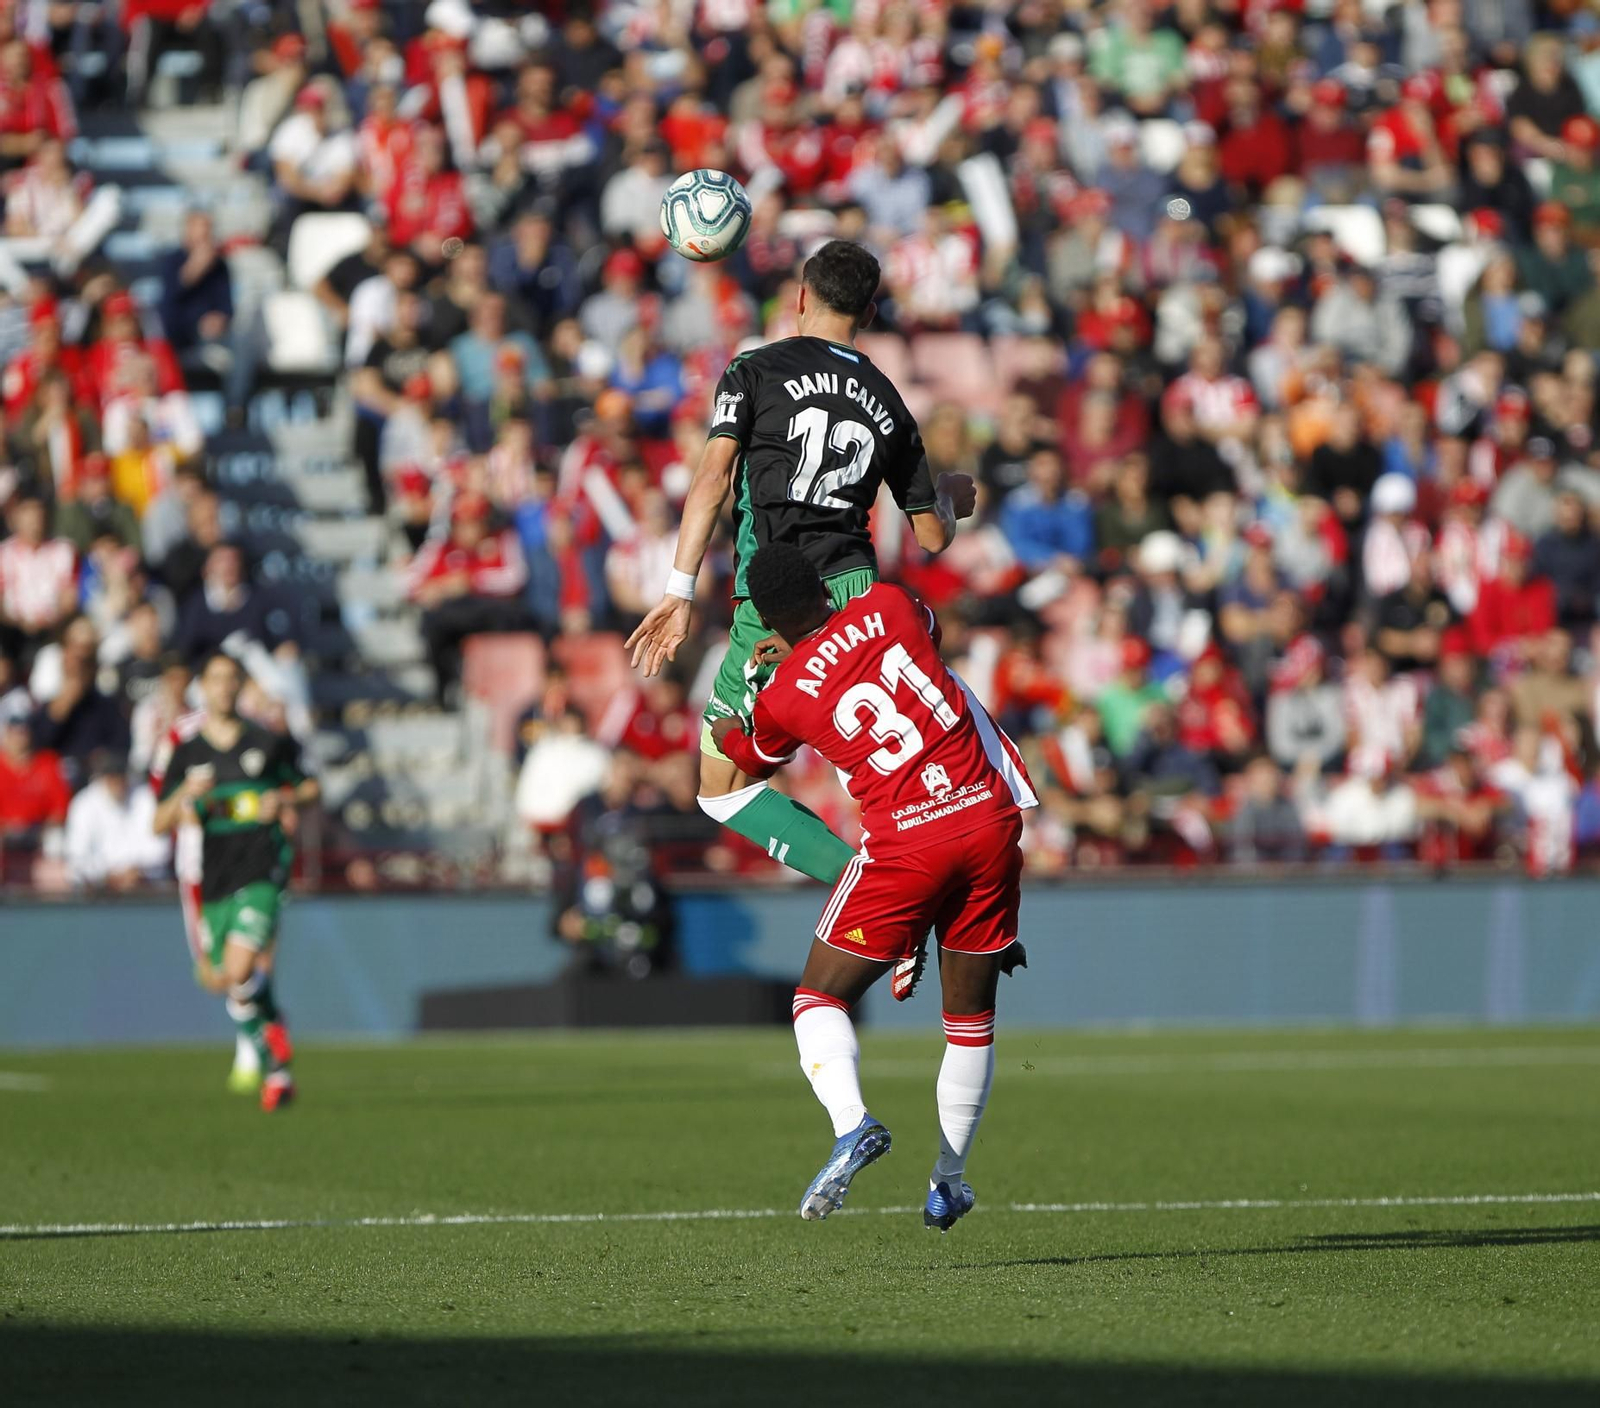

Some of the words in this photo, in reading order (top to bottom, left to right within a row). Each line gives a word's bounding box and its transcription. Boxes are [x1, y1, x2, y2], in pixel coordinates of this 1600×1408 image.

[783, 373, 839, 401] DANI
[845, 377, 895, 436] CALVO
[787, 406, 875, 509] 12
[795, 612, 886, 699] APPIAH
[833, 642, 961, 776] 31
[897, 815, 925, 832] ABDUL
[923, 805, 953, 822] SAMAD
[844, 933, 867, 946] adidas
